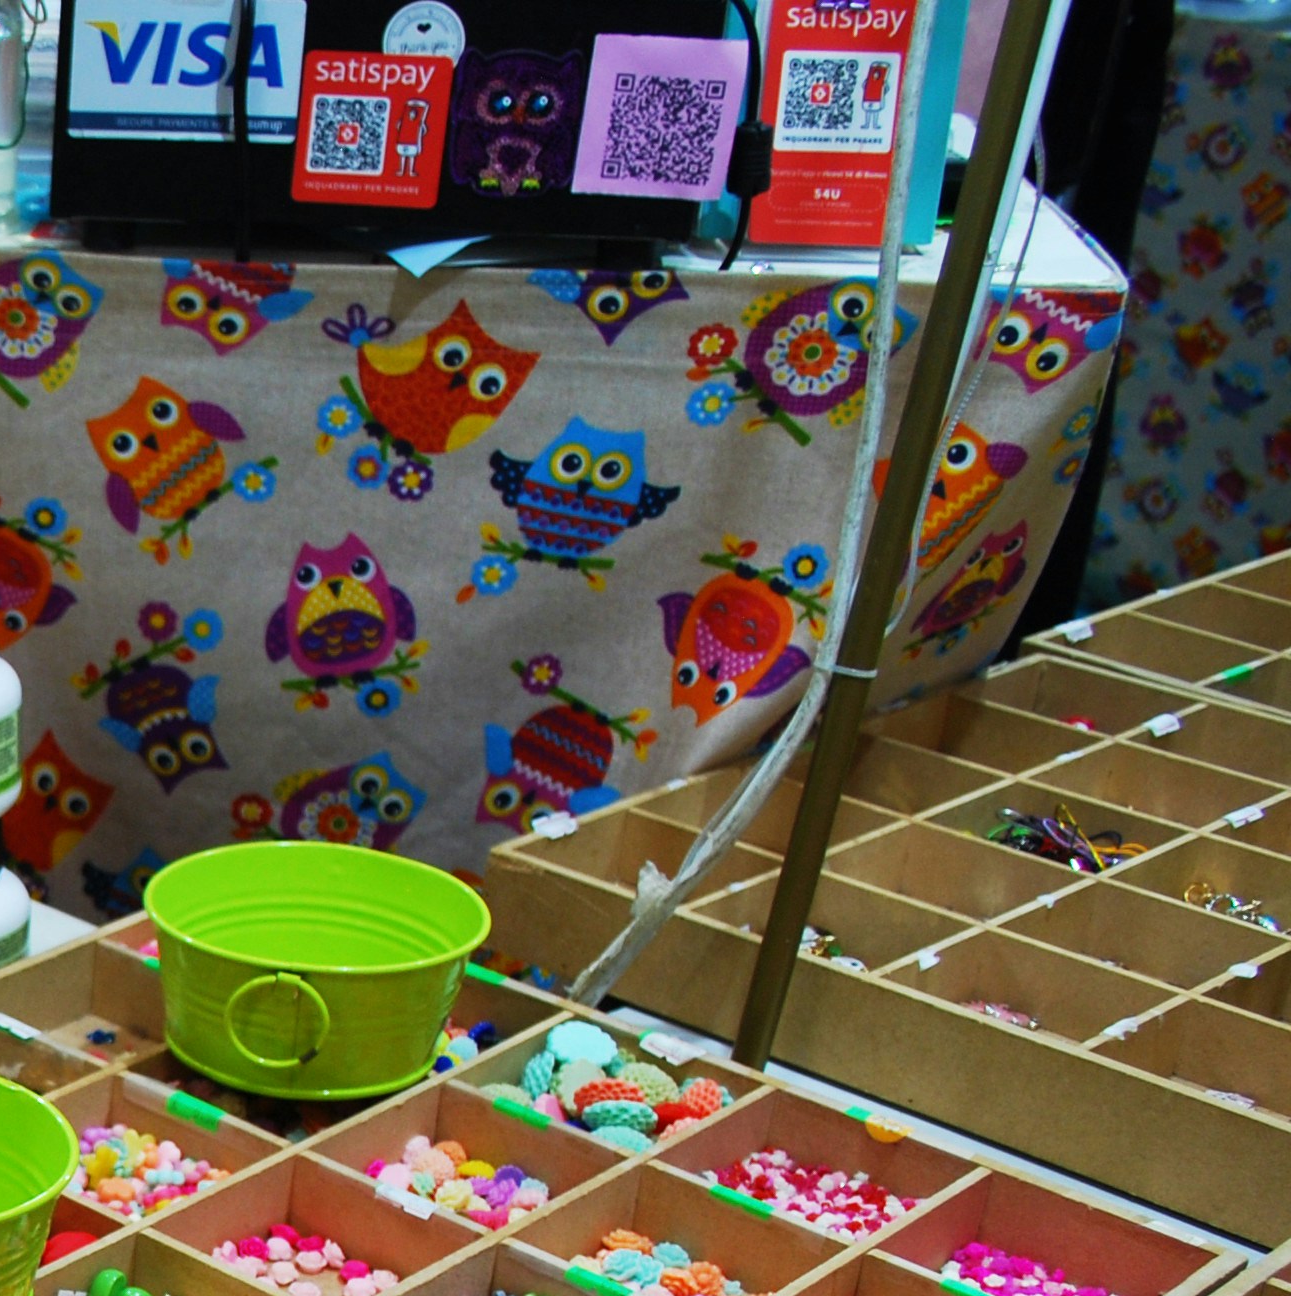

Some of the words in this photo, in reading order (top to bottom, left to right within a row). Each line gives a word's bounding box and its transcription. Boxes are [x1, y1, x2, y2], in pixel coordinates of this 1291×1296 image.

[786, 7, 907, 38] satispay
[84, 21, 285, 88] VISA
[315, 57, 436, 93] satispay
[365, 182, 382, 193] PER
